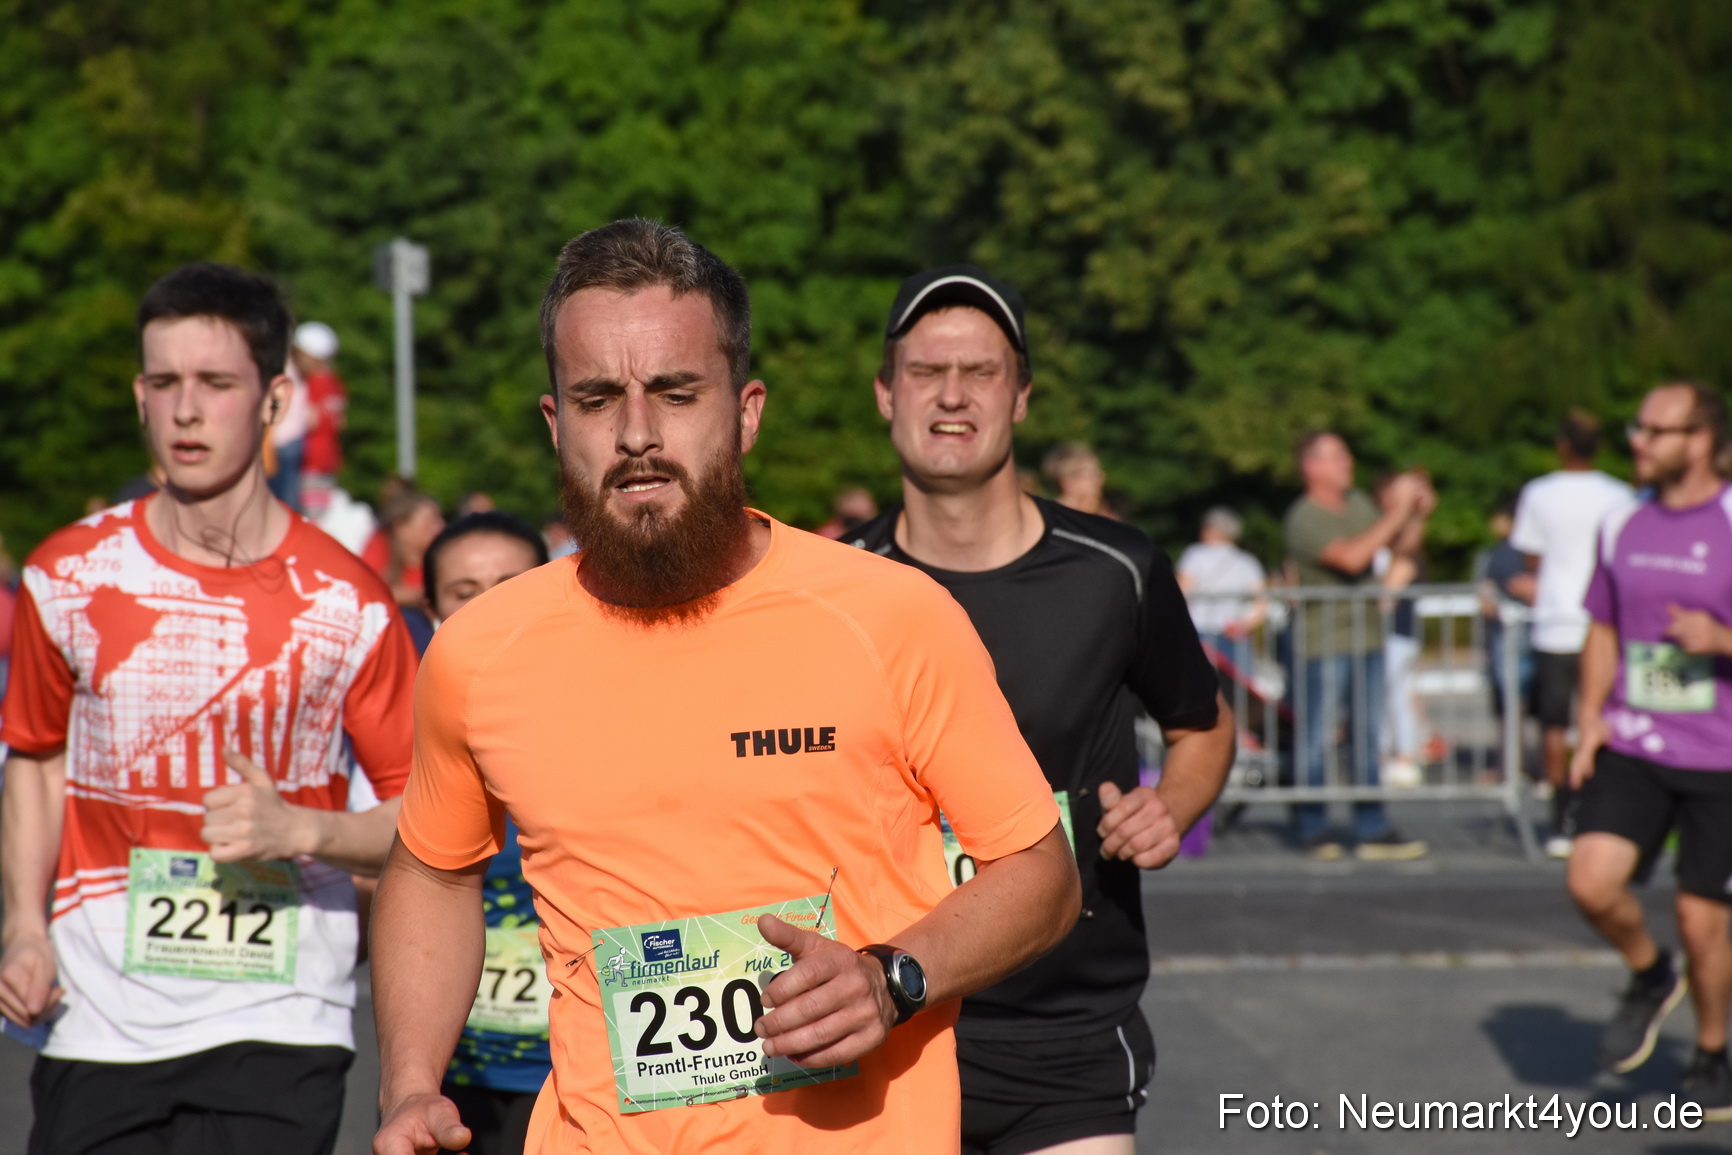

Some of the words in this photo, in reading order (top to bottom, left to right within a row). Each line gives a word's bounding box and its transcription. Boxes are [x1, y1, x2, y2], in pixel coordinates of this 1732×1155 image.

[730, 727, 836, 758] THULE
[808, 744, 833, 752] SWEDEN
[146, 896, 274, 946] 2212
[649, 938, 676, 948] Fischer
[629, 949, 720, 978] firmenlauf
[744, 957, 773, 973] run
[479, 966, 537, 1002] 72
[631, 975, 671, 986] neumarkt
[629, 970, 785, 1057] 230
[636, 1050, 758, 1078] Prantl-Frunzo
[691, 1072, 726, 1087] Thule
[729, 1063, 769, 1081] GmbH
